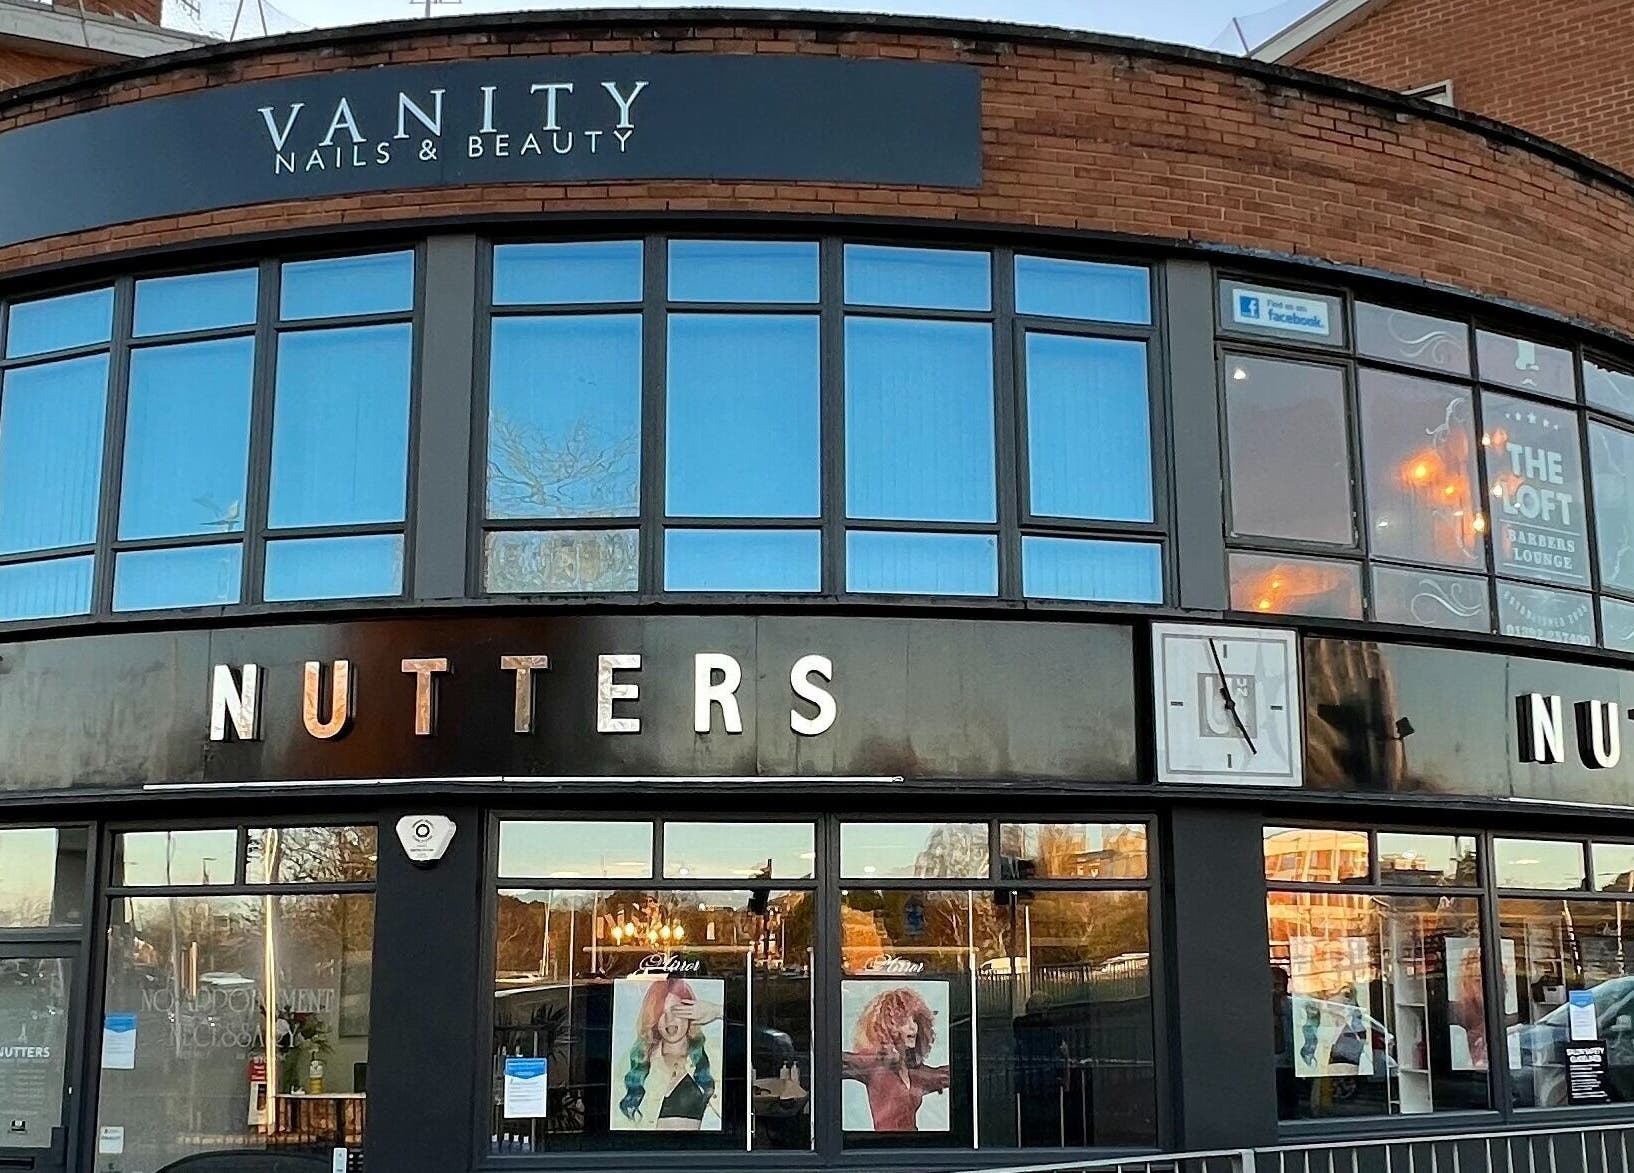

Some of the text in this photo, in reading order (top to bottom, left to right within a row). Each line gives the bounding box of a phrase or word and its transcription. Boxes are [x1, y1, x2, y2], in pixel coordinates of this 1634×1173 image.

[257, 80, 649, 152] VANITY
[275, 129, 633, 175] NAILS & BEAUTY
[1506, 442, 1564, 485] THE
[1501, 481, 1573, 526] LOFT
[1507, 528, 1575, 553] BARBERS
[1513, 548, 1574, 570] LOUNGE
[210, 652, 837, 742] NUTTERS
[1516, 692, 1634, 769] NU
[183, 987, 334, 1014] APPOIMENT
[169, 1022, 299, 1048] NECESSAY
